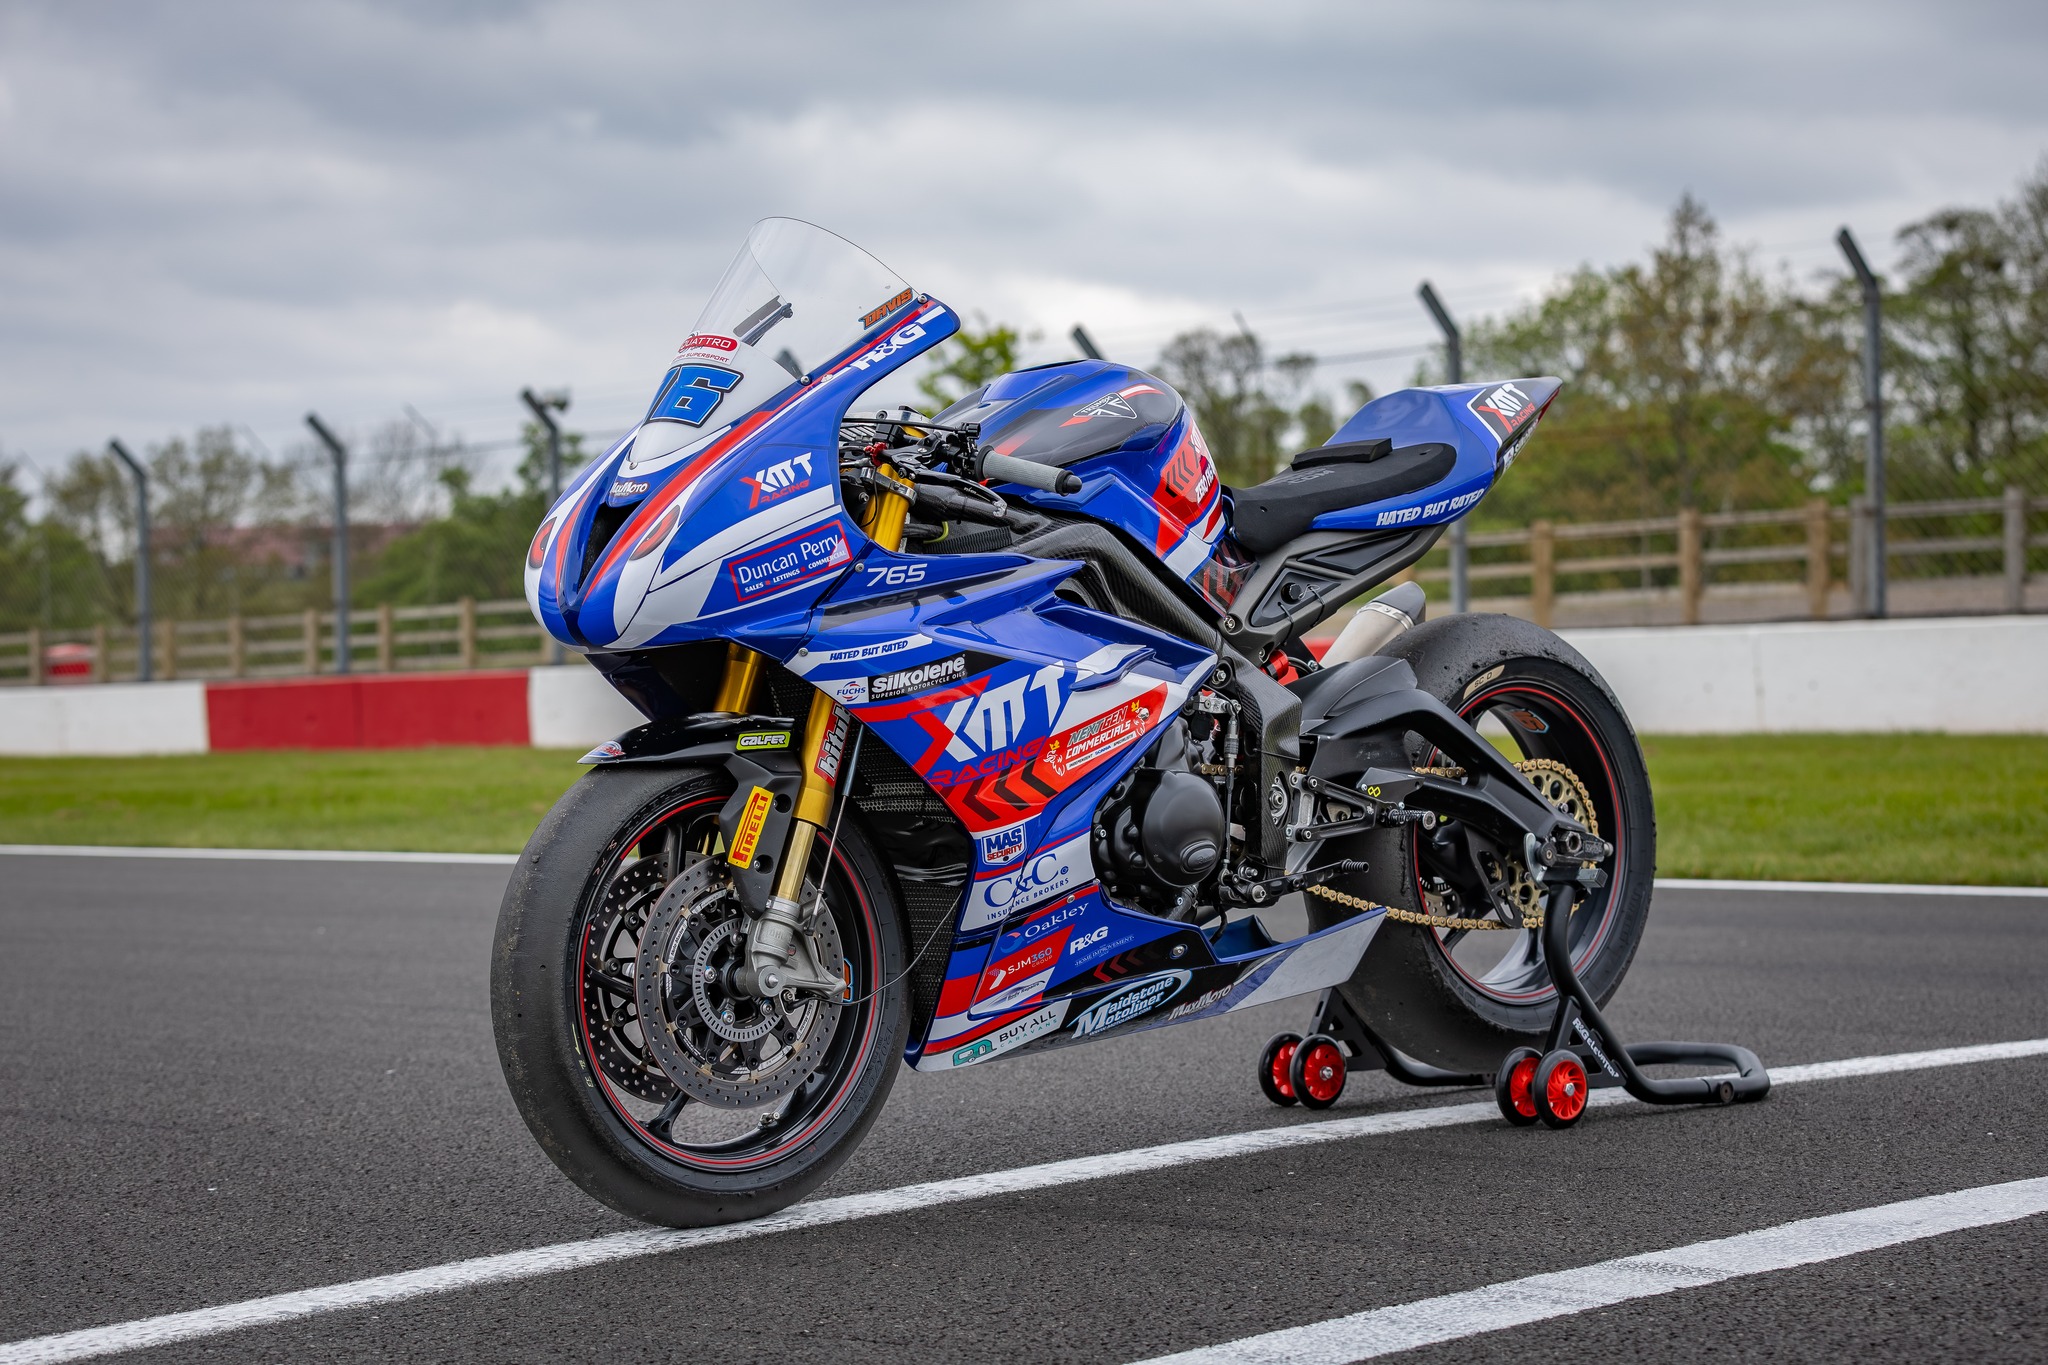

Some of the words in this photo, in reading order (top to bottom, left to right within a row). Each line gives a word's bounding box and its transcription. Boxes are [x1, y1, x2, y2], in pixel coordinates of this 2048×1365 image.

[862, 287, 913, 329] DAVIS
[686, 352, 730, 363] SUPERSPORT
[850, 323, 927, 371] R&G
[1478, 383, 1531, 434] XMT
[1510, 402, 1536, 428] RACING
[739, 452, 813, 510] XMT
[760, 479, 811, 504] RACING
[1376, 506, 1422, 527] HATED
[1422, 499, 1450, 518] BUT
[1448, 487, 1485, 511] RATED
[738, 551, 799, 584] Duncan
[800, 534, 840, 561] Perry
[744, 581, 764, 594] SALES
[772, 567, 802, 584] LETTINGS
[807, 549, 847, 570] COMMERCIAL
[866, 563, 928, 587] 765
[829, 648, 861, 662] HATED
[861, 646, 881, 656] BUT
[880, 640, 909, 654] RATED
[870, 687, 905, 700] SUPERIOR
[907, 676, 950, 693] MOTORCYCLE
[951, 671, 967, 681] OILS
[871, 656, 966, 693] Silkolene
[836, 686, 867, 696] FUCHS
[910, 660, 1065, 777] XMT
[740, 734, 787, 746] GALFER
[1065, 719, 1132, 760] COMMERCIALS
[927, 735, 1047, 787] RACING
[732, 791, 769, 863] PIRELLI
[985, 828, 1022, 853] MAS
[986, 843, 1023, 861] SECURITY
[984, 853, 1059, 907] C&C
[1033, 877, 1069, 899] BROKERS
[1024, 902, 1090, 938] Oakley
[1069, 926, 1109, 955] R&G
[1007, 947, 1053, 975] SJM360
[1031, 954, 1053, 968] GROUP
[1000, 1019, 1058, 1048] CARAVANS
[1572, 1017, 1590, 1040] R&G
